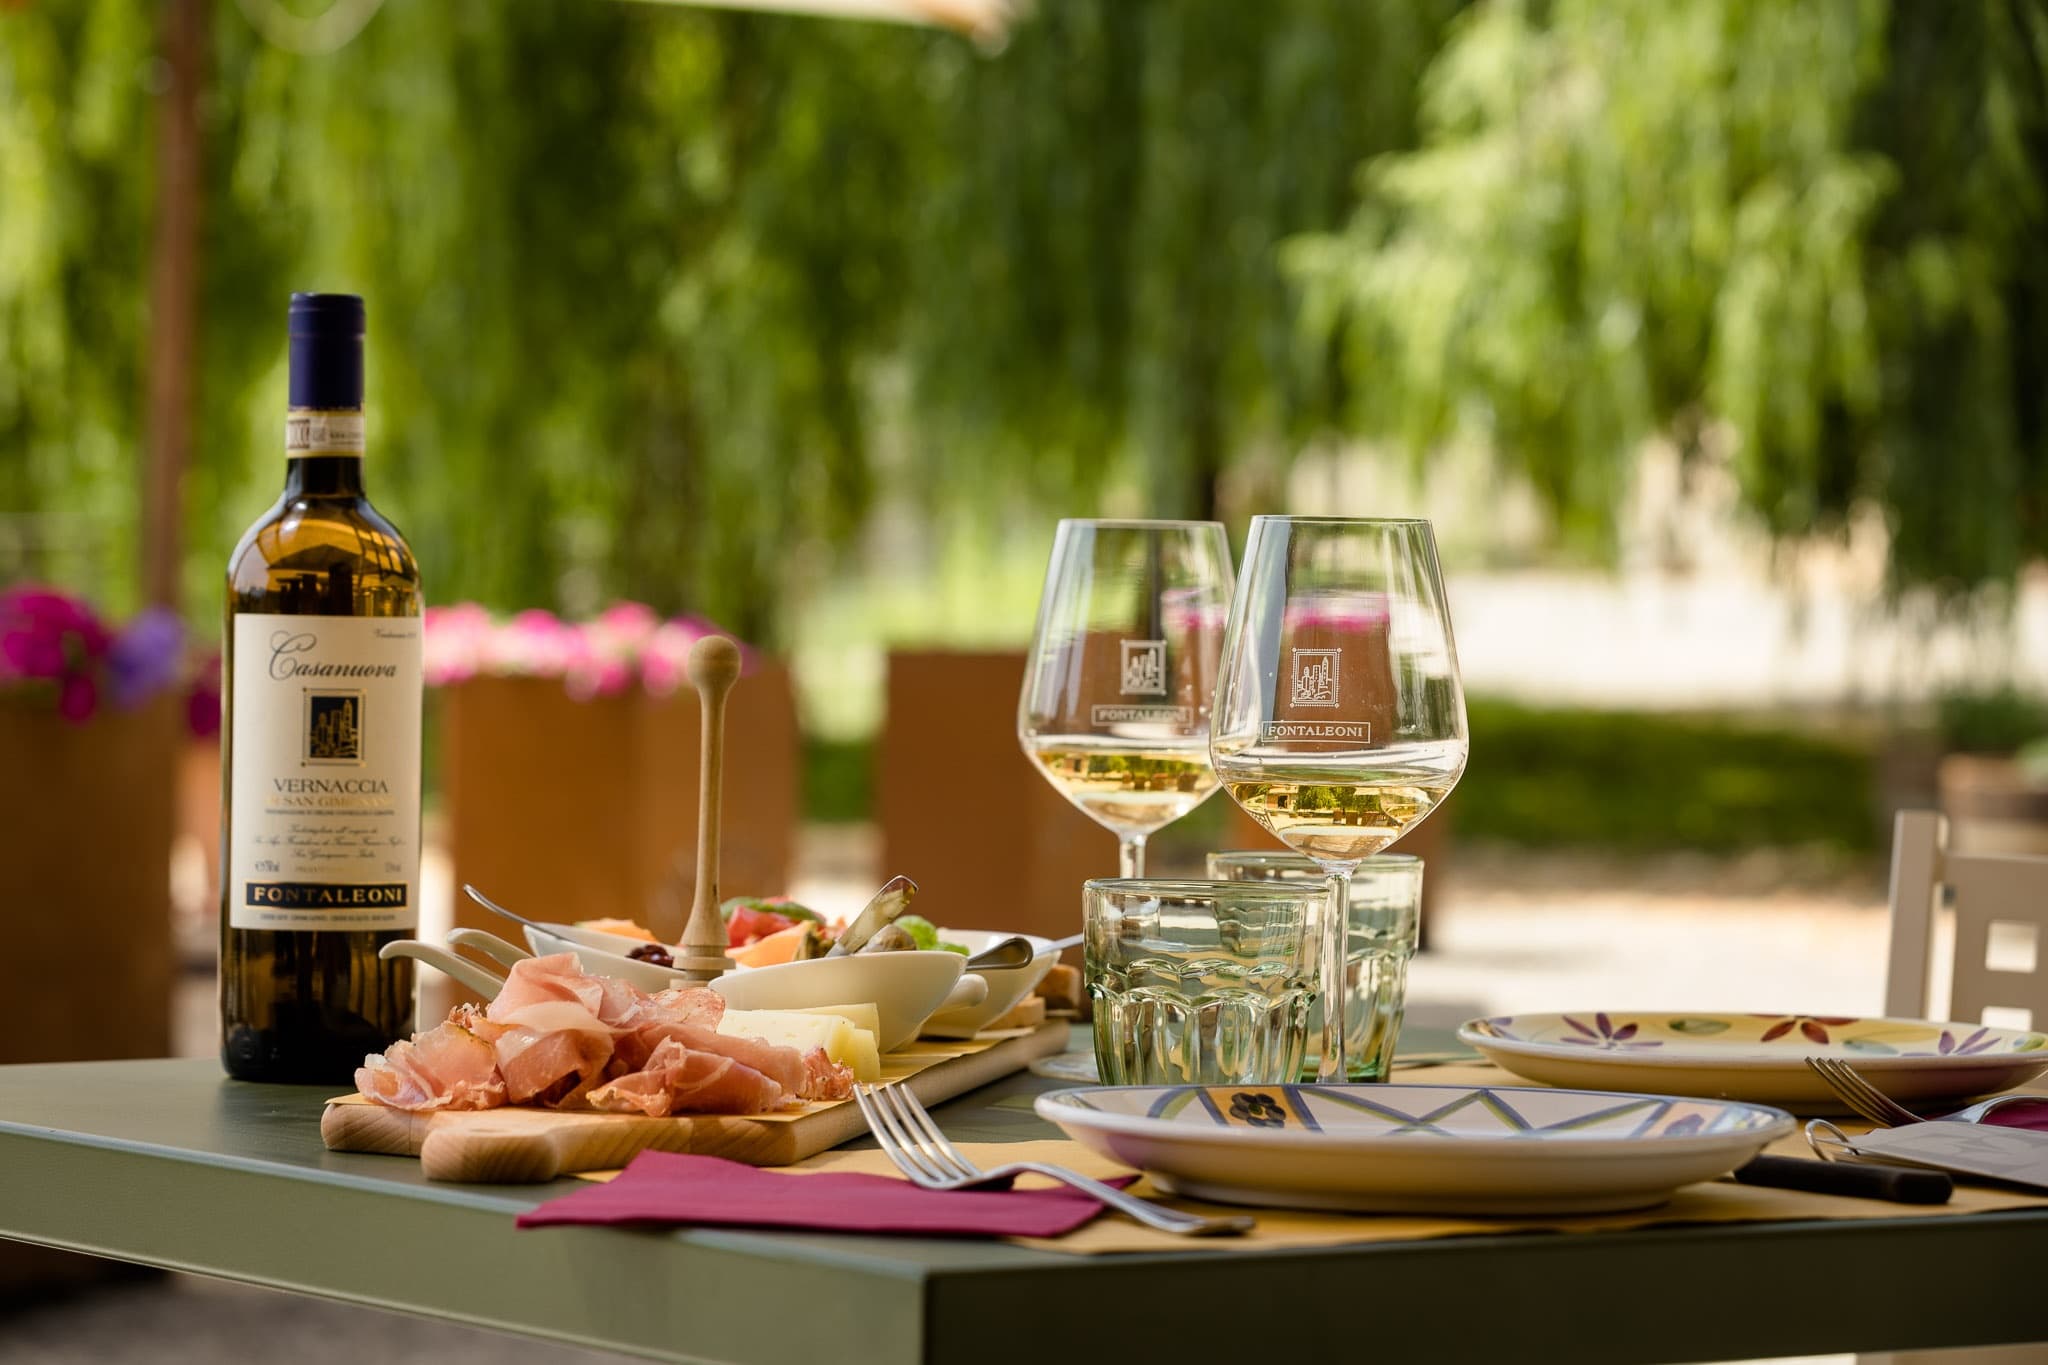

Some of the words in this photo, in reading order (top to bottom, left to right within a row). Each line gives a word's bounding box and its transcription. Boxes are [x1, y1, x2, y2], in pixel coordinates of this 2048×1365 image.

[269, 630, 397, 681] Casanuova
[1268, 725, 1363, 737] FONTALEONI
[273, 778, 389, 793] VERNACCIA
[253, 886, 403, 903] FONTALEONI
